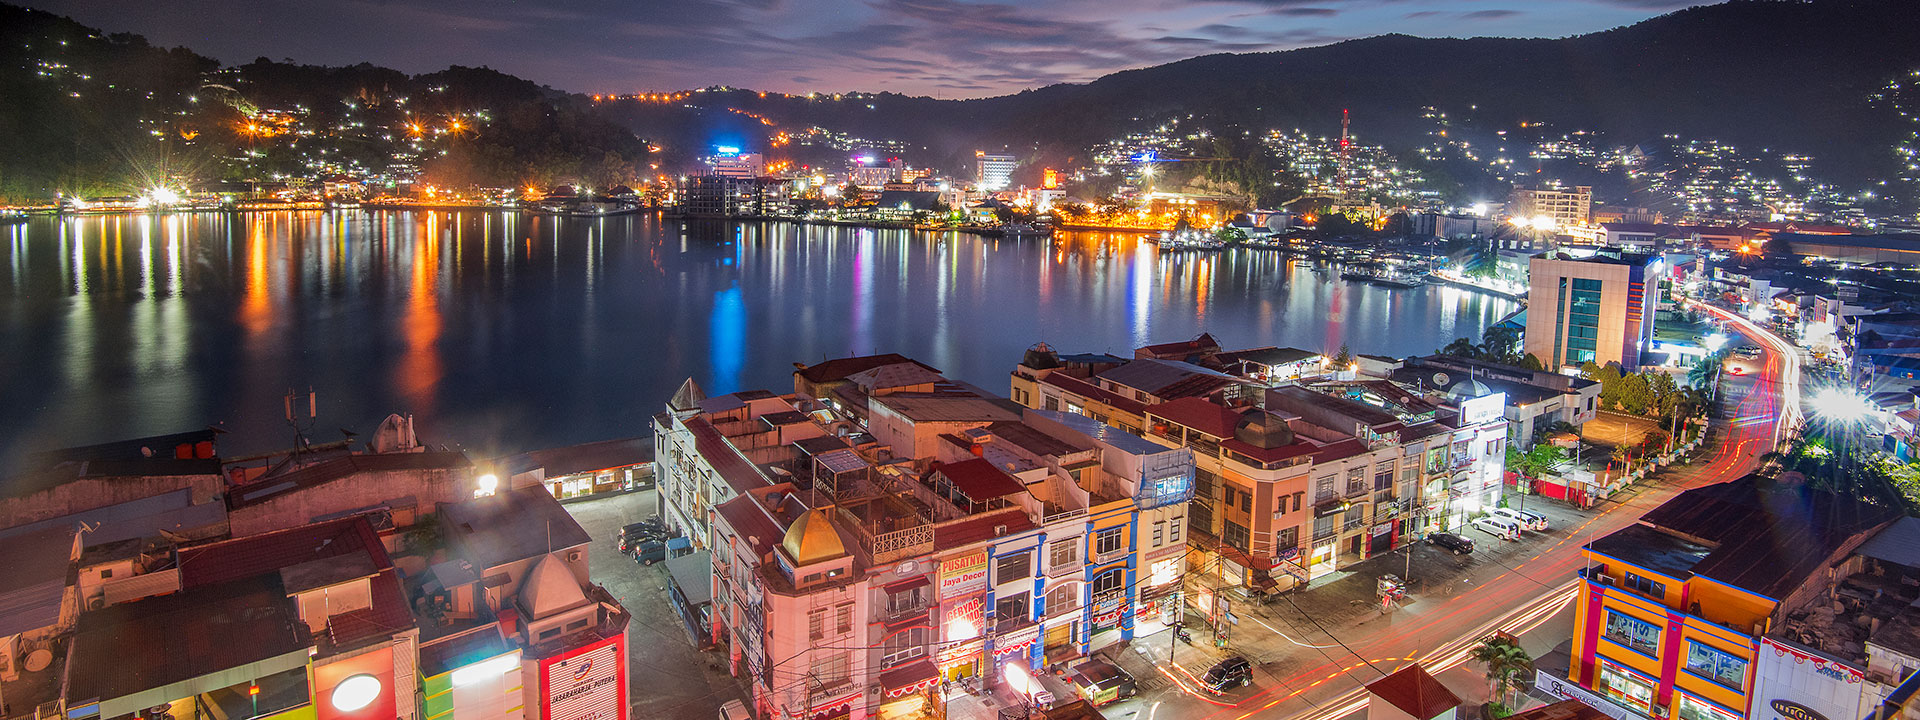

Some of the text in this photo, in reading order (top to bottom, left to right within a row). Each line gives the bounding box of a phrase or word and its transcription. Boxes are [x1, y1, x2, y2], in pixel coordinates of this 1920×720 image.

[943, 553, 986, 573] PUSATNYA
[943, 576, 961, 587] Jaya
[963, 571, 986, 582] Decor
[947, 599, 980, 622] GEBYAR
